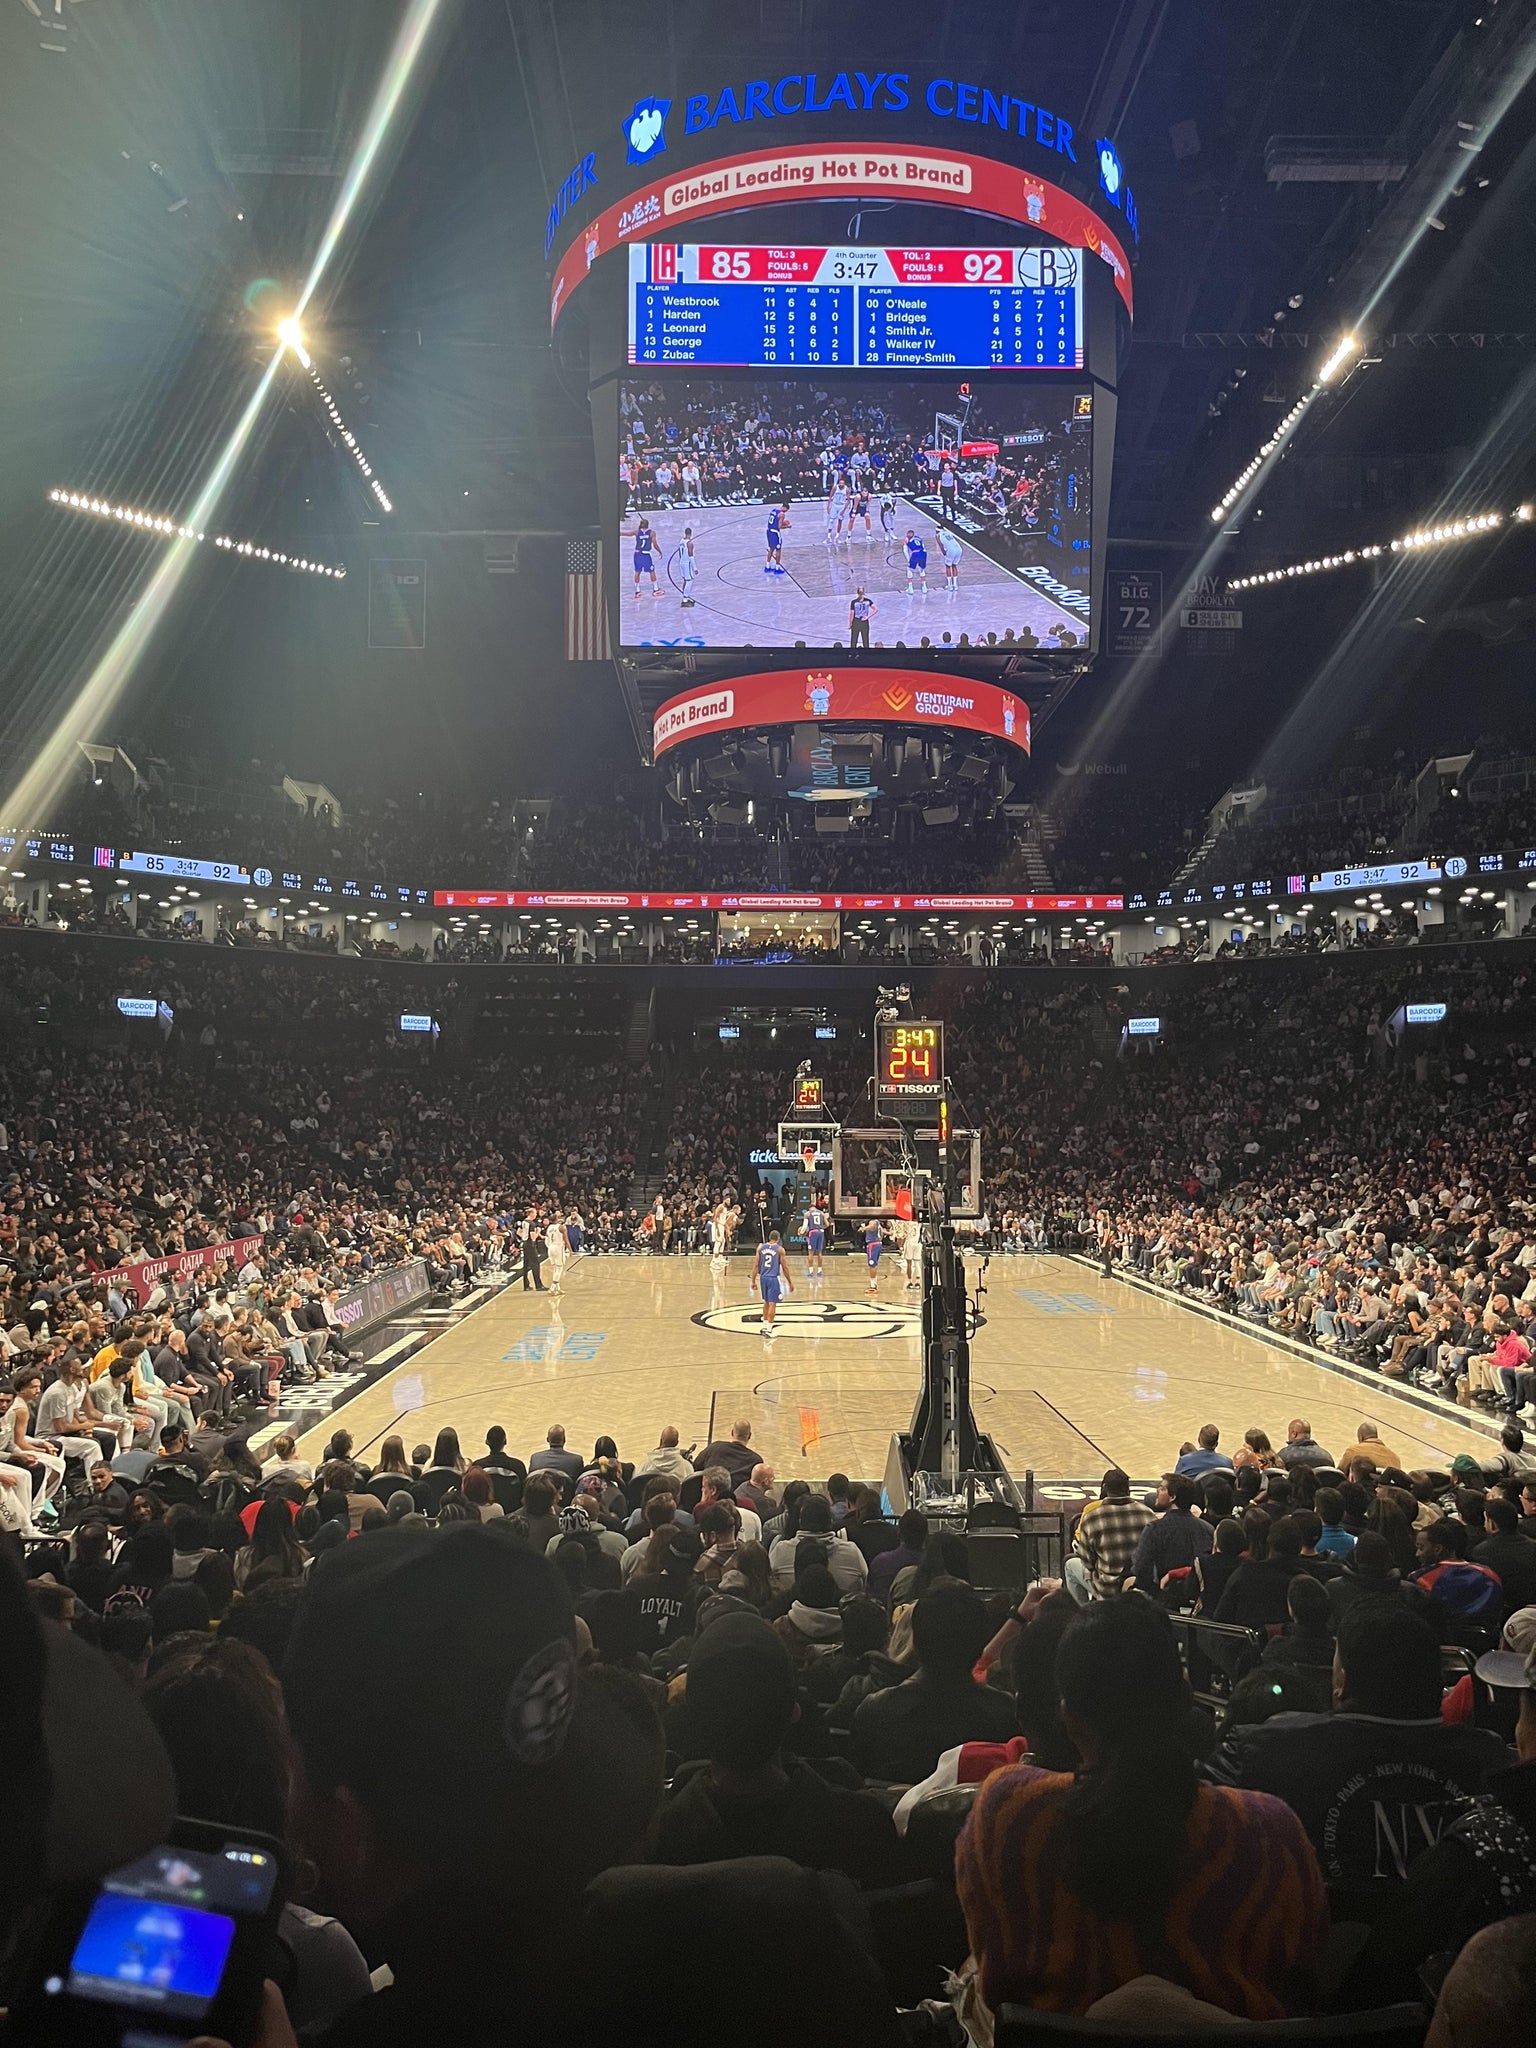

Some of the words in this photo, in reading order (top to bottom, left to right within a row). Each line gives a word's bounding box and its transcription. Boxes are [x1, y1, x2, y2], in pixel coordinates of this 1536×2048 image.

[684, 70, 911, 137] BARCLAYS
[925, 77, 1079, 164] CENTER
[671, 175, 729, 207] Global
[735, 163, 815, 186] Leading
[821, 159, 858, 178] Hot
[864, 160, 898, 180] Pot
[905, 164, 965, 186] Brand
[849, 252, 877, 260] Quarter
[712, 252, 750, 278] 85
[833, 262, 879, 280] 3:47
[964, 254, 1002, 281] 92
[767, 272, 793, 280] BONUS
[647, 296, 653, 305] 0
[663, 296, 719, 306] Westbrook
[765, 298, 775, 307] 11
[789, 298, 794, 307] 6
[810, 299, 816, 307] 4
[833, 299, 837, 307] 1
[867, 299, 878, 308] 00
[886, 299, 927, 308] O'Neale
[993, 300, 999, 309] 9
[1015, 300, 1021, 309] 2
[1037, 300, 1043, 309] 7
[1060, 300, 1064, 309] 1
[648, 310, 652, 318] 1
[664, 310, 700, 319] Harden
[764, 312, 775, 320] 12
[789, 312, 794, 320] 5
[810, 312, 816, 321] 8
[832, 313, 838, 321] 0
[871, 313, 875, 321] 1
[887, 313, 926, 324] Bridges
[993, 314, 999, 322] 8
[1015, 314, 1021, 322] 6
[1037, 314, 1043, 322] 7
[1060, 314, 1064, 322] 1
[647, 323, 653, 332] 2
[664, 323, 706, 332] Leonard
[764, 325, 775, 333] 15
[789, 325, 794, 334] 2
[810, 325, 816, 334] 6
[833, 326, 837, 334] 1
[869, 326, 875, 335] 4
[886, 326, 916, 335] Smith
[920, 326, 932, 335] Jr.
[993, 327, 999, 335] 4
[1015, 327, 1021, 335] 5
[1038, 327, 1042, 335] 1
[1058, 327, 1064, 336] 4
[645, 336, 656, 345] 13
[663, 337, 701, 348] George
[764, 338, 775, 347] 23
[790, 339, 794, 347] 1
[810, 339, 816, 347] 6
[832, 339, 838, 348] 2
[870, 339, 875, 348] 8
[886, 339, 922, 348] Walker
[925, 340, 935, 348] IV
[991, 340, 1002, 349] 21
[1015, 340, 1021, 349] 0
[1037, 341, 1043, 349] 0
[1059, 341, 1065, 349] 0
[644, 350, 656, 358] 40
[663, 350, 694, 359] Zubac
[764, 352, 775, 360] 10
[790, 352, 794, 360] 1
[808, 352, 819, 361] 10
[832, 352, 838, 361] 5
[867, 353, 878, 361] 28
[887, 353, 955, 364] Finney-Smith
[991, 354, 1002, 362] 12
[1016, 354, 1021, 362] 2
[1037, 354, 1043, 362] 9
[1059, 354, 1065, 362] 2
[1121, 586, 1151, 599] B.I.G.
[1119, 607, 1151, 628] 72
[1188, 612, 1198, 626] 8
[915, 692, 975, 710] VENTURANT
[670, 710, 686, 729] Pot
[688, 696, 728, 721] Brand
[915, 702, 955, 716] GROUP
[1085, 764, 1128, 775] Webull
[146, 857, 164, 871] 85
[177, 861, 199, 871] 3:47
[213, 866, 230, 879] 92
[1363, 869, 1385, 879] 3:47
[1400, 865, 1419, 879] 92
[1334, 873, 1351, 886] 85
[120, 1001, 154, 1010] BARCODE
[1410, 1007, 1444, 1015] BARCODE
[897, 1029, 935, 1047] 3:47
[890, 1048, 930, 1079] 24
[899, 1085, 940, 1093] TISSOT
[799, 1090, 817, 1103] 24
[180, 1253, 204, 1274] QATAR
[764, 1255, 772, 1268] 2
[142, 1261, 168, 1284] QATAR
[335, 1299, 364, 1324] TISSOT
[658, 1616, 668, 1635] 1
[1324, 1807, 1340, 1850] TOKYO
[1336, 1774, 1366, 1802] PARIS
[1375, 1762, 1403, 1777] NEW
[1407, 1763, 1438, 1782] YORK
